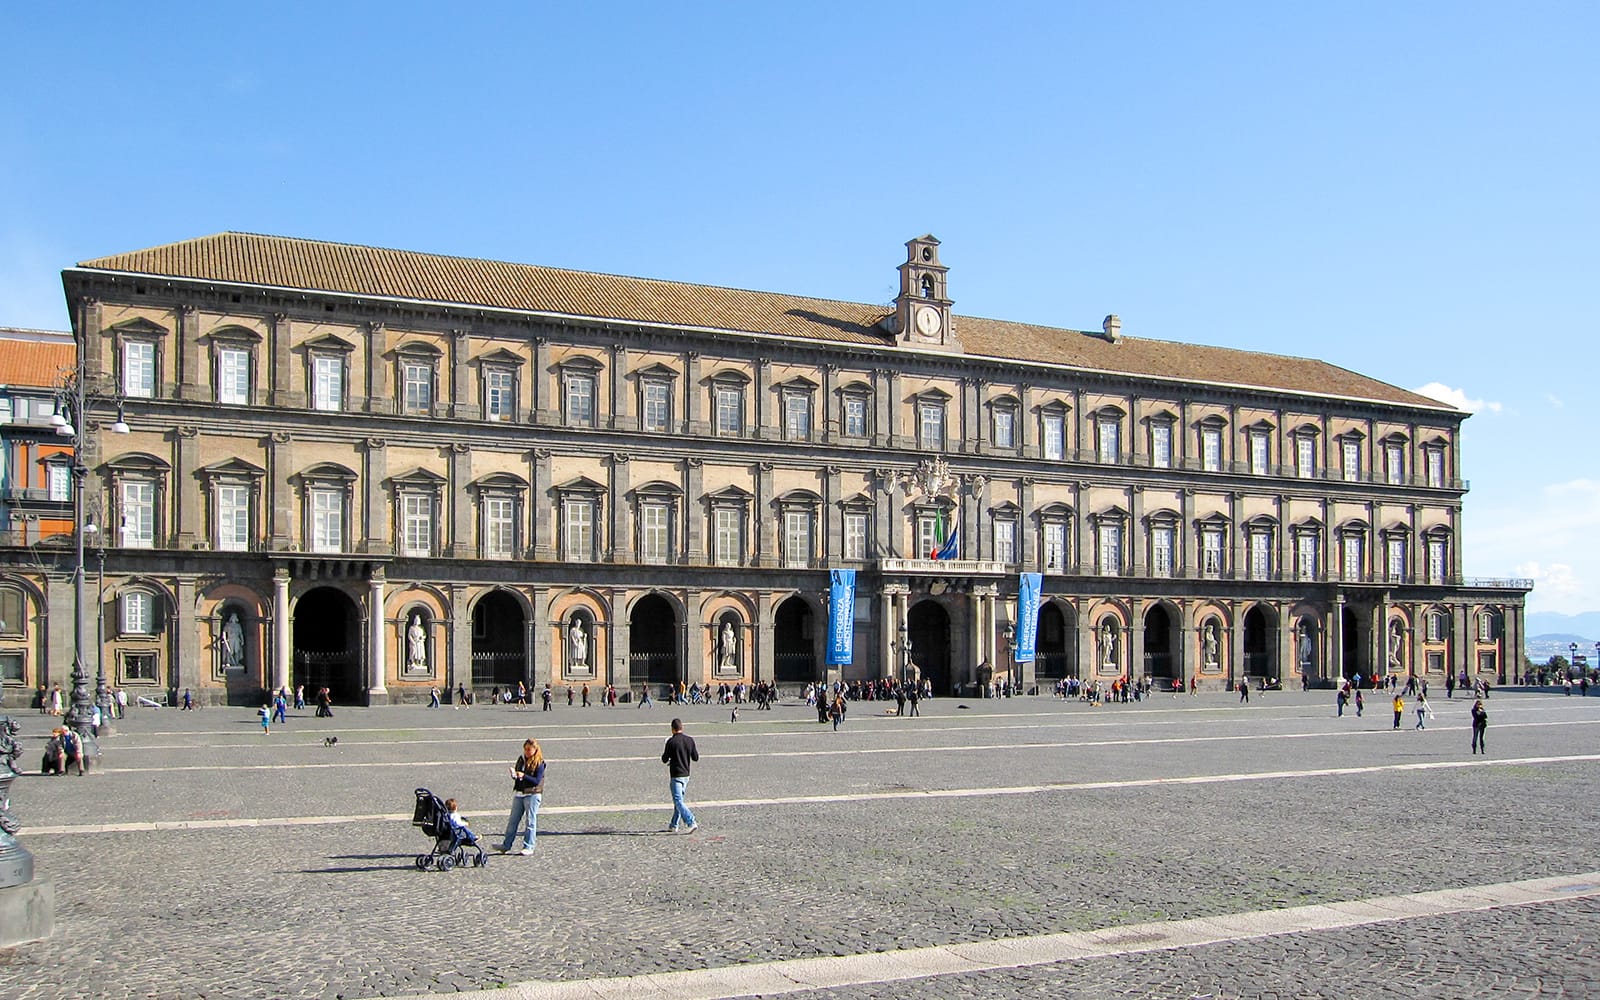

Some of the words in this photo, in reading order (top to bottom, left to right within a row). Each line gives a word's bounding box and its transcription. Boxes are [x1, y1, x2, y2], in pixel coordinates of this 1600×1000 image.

[835, 598, 845, 652] EMERGENZA
[843, 585, 852, 652] MEDITERRANEA
[1022, 600, 1032, 650] EMERGENZA
[1029, 587, 1040, 650] MEDITERRANEA
